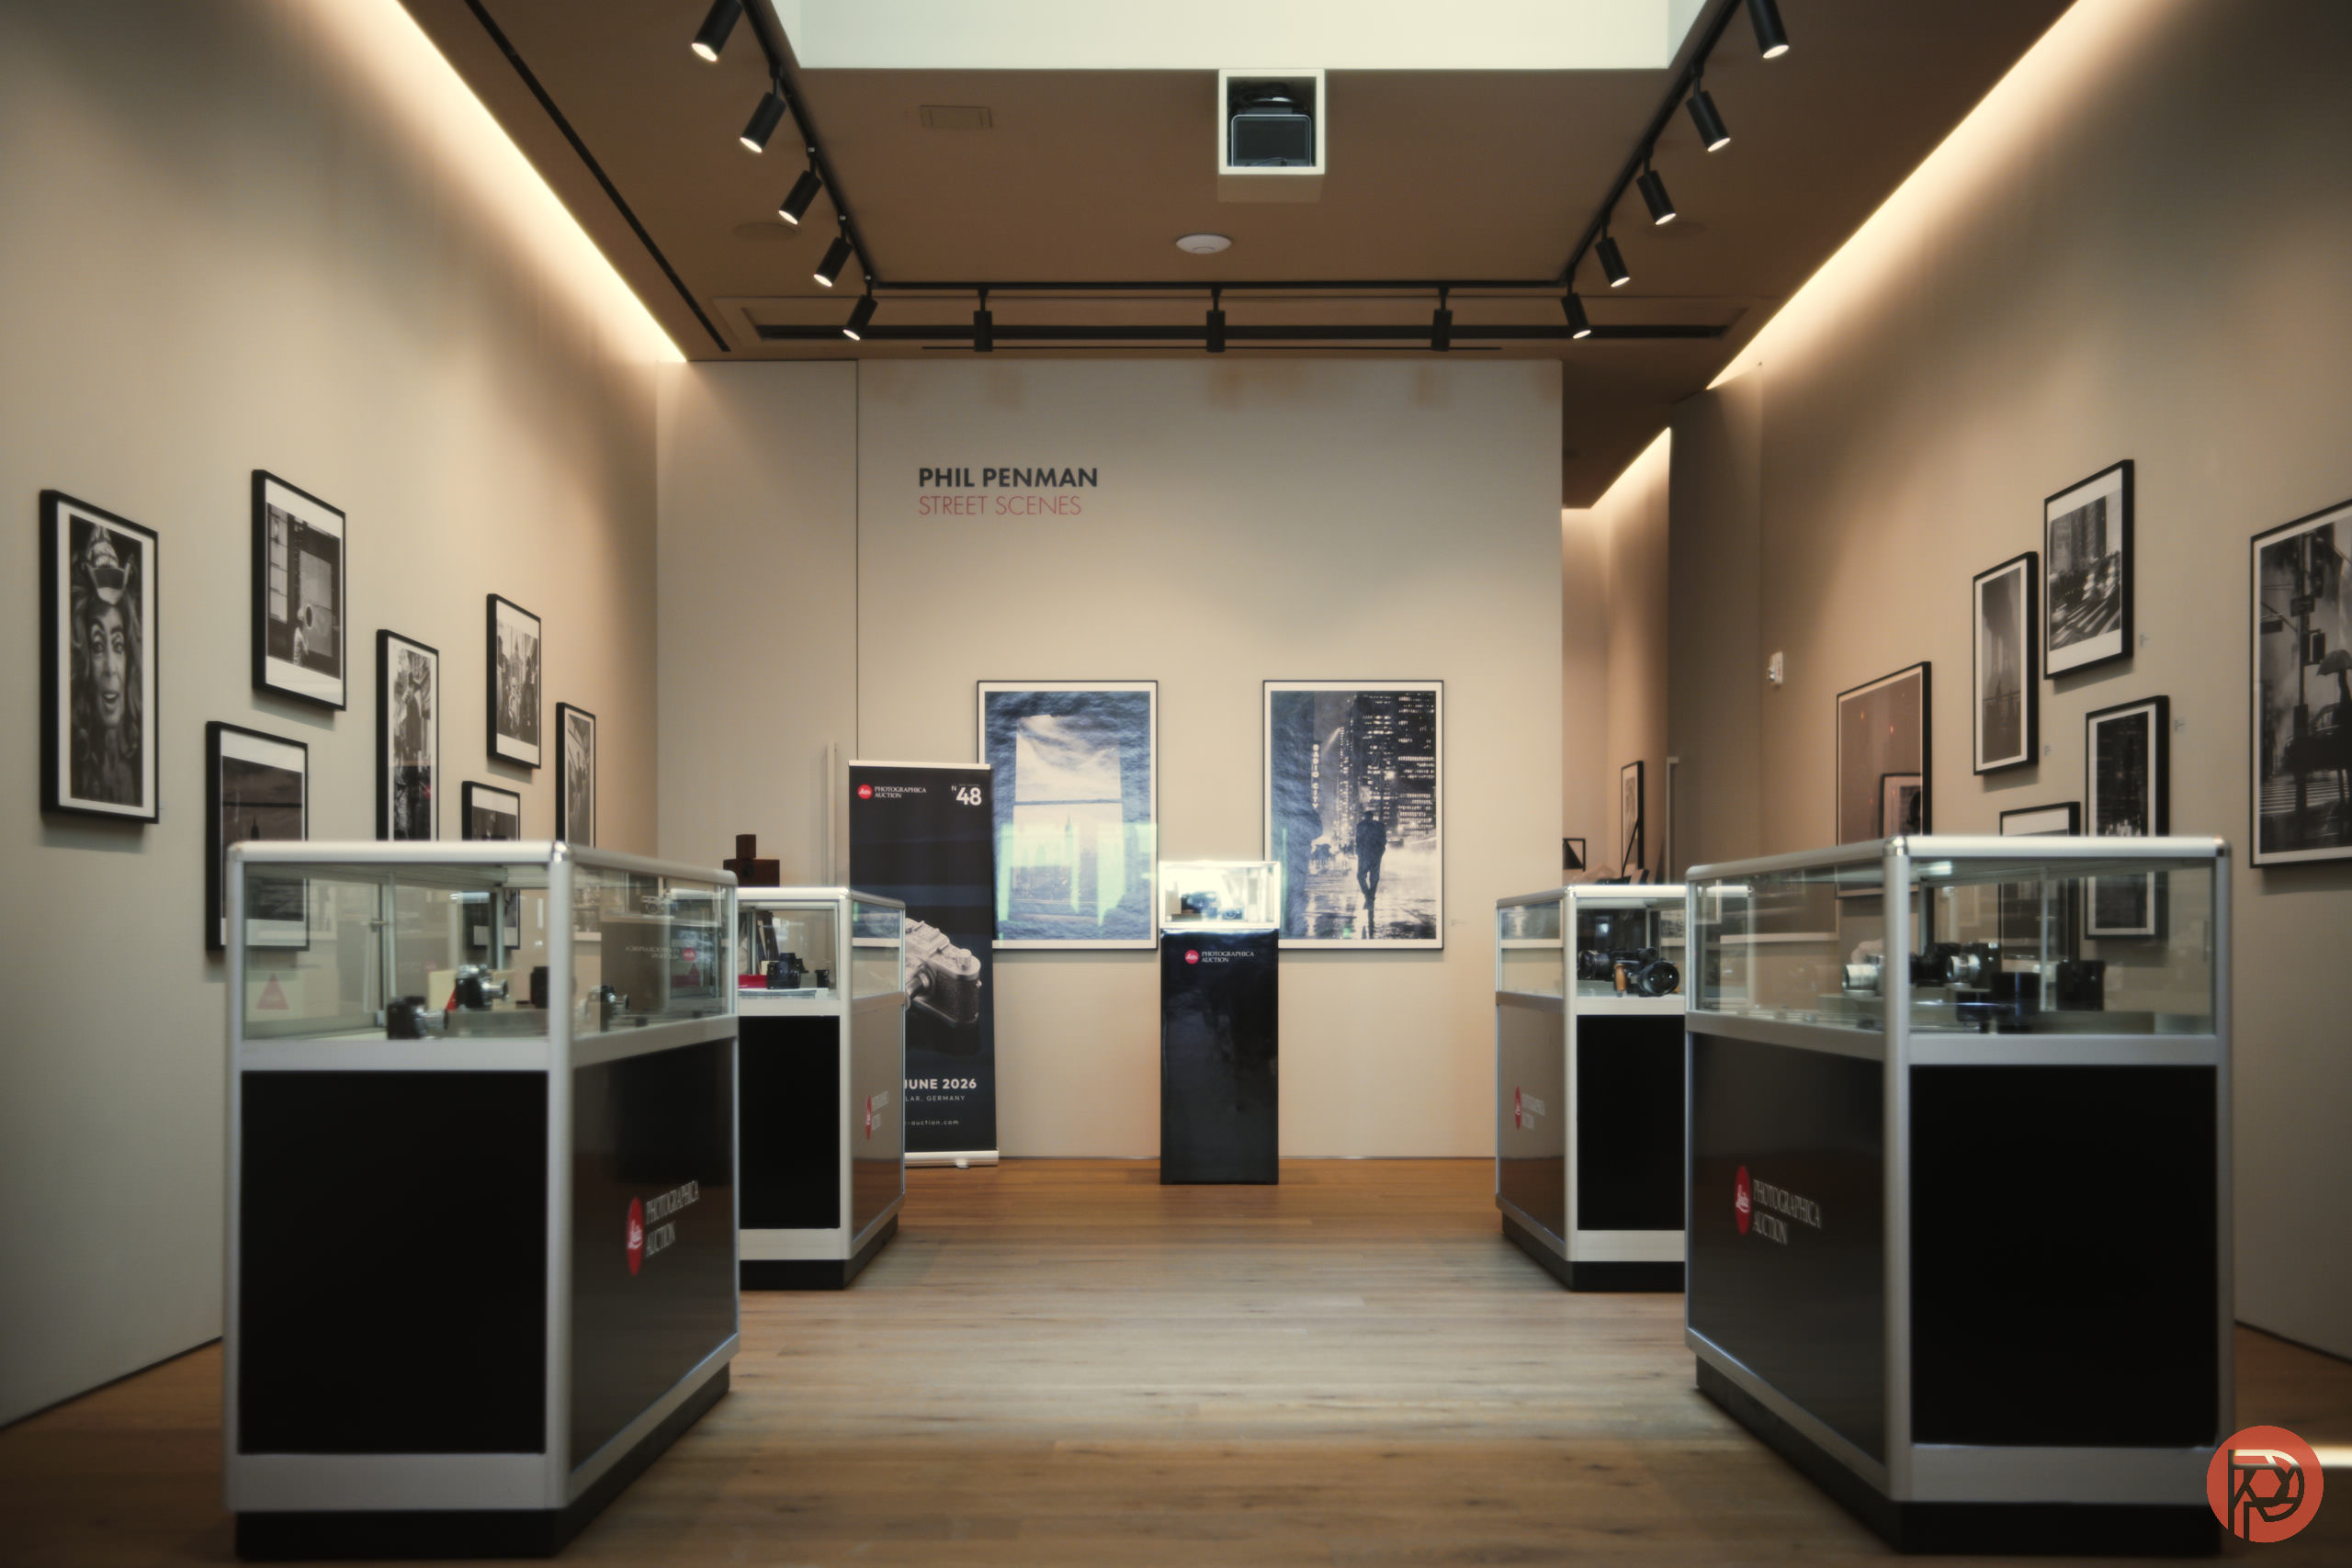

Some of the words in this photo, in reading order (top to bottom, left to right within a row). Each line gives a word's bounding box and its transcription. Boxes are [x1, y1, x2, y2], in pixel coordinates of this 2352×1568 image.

[919, 468, 975, 488] PHIL
[982, 468, 1098, 488] PENMAN
[919, 495, 988, 515] STREET
[995, 495, 1082, 515] SCENES
[875, 785, 927, 794] PHOTOGRAPHICA
[956, 786, 982, 806] 48
[942, 1078, 977, 1089] 2026
[1752, 1179, 1822, 1229] PHOTOGRAPHICA
[1752, 1210, 1788, 1246] AUCTION
